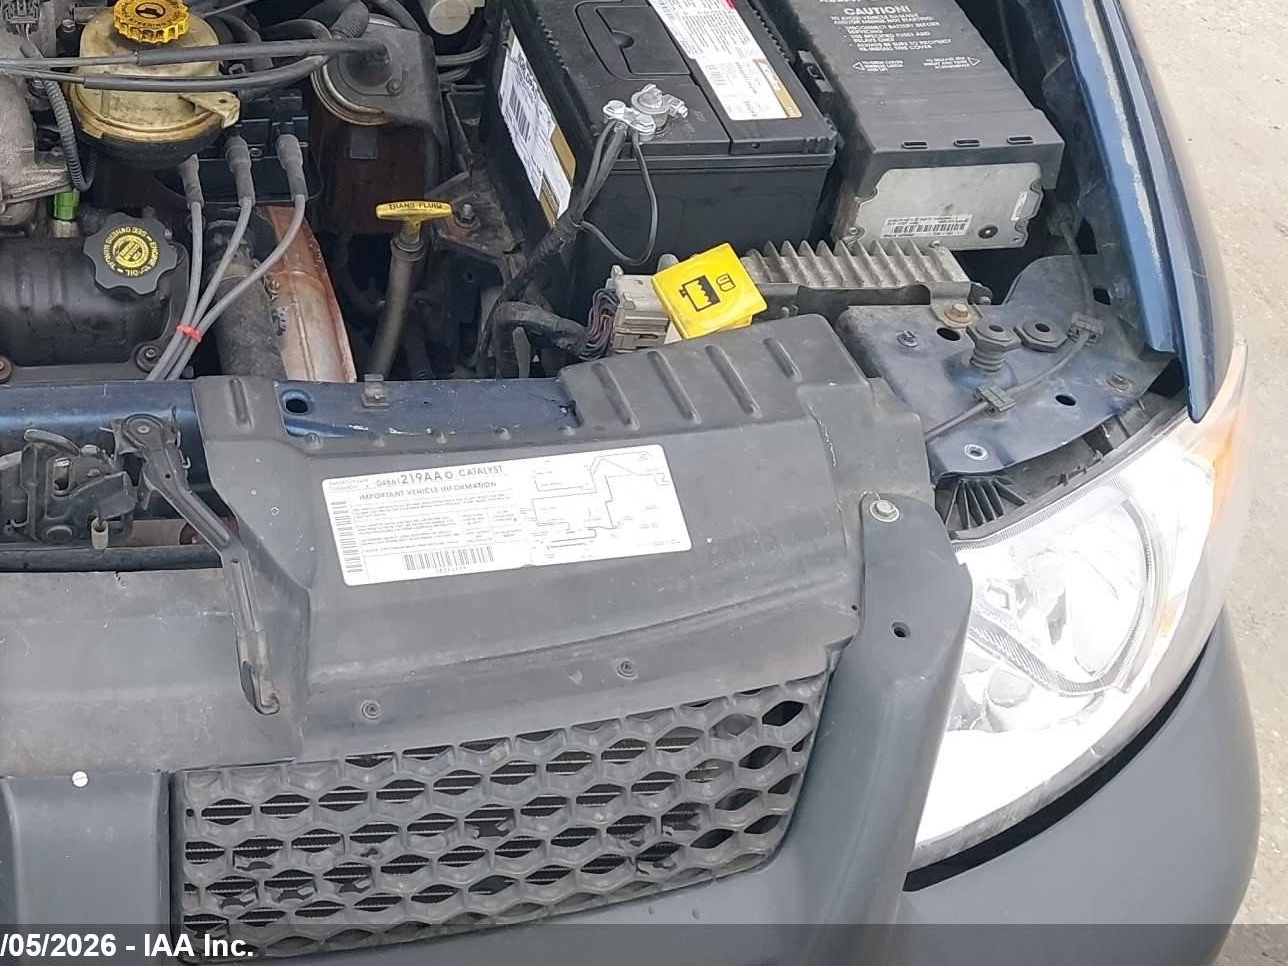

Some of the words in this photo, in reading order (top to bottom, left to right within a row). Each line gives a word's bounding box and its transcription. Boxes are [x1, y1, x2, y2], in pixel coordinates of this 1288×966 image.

[843, 5, 912, 16] CAUTION!
[125, 269, 139, 277] OIL
[458, 465, 504, 477] CATALYST
[359, 490, 405, 501] IMPORTANT
[407, 486, 439, 496] VEHICLE
[441, 481, 497, 492] INFORMATION
